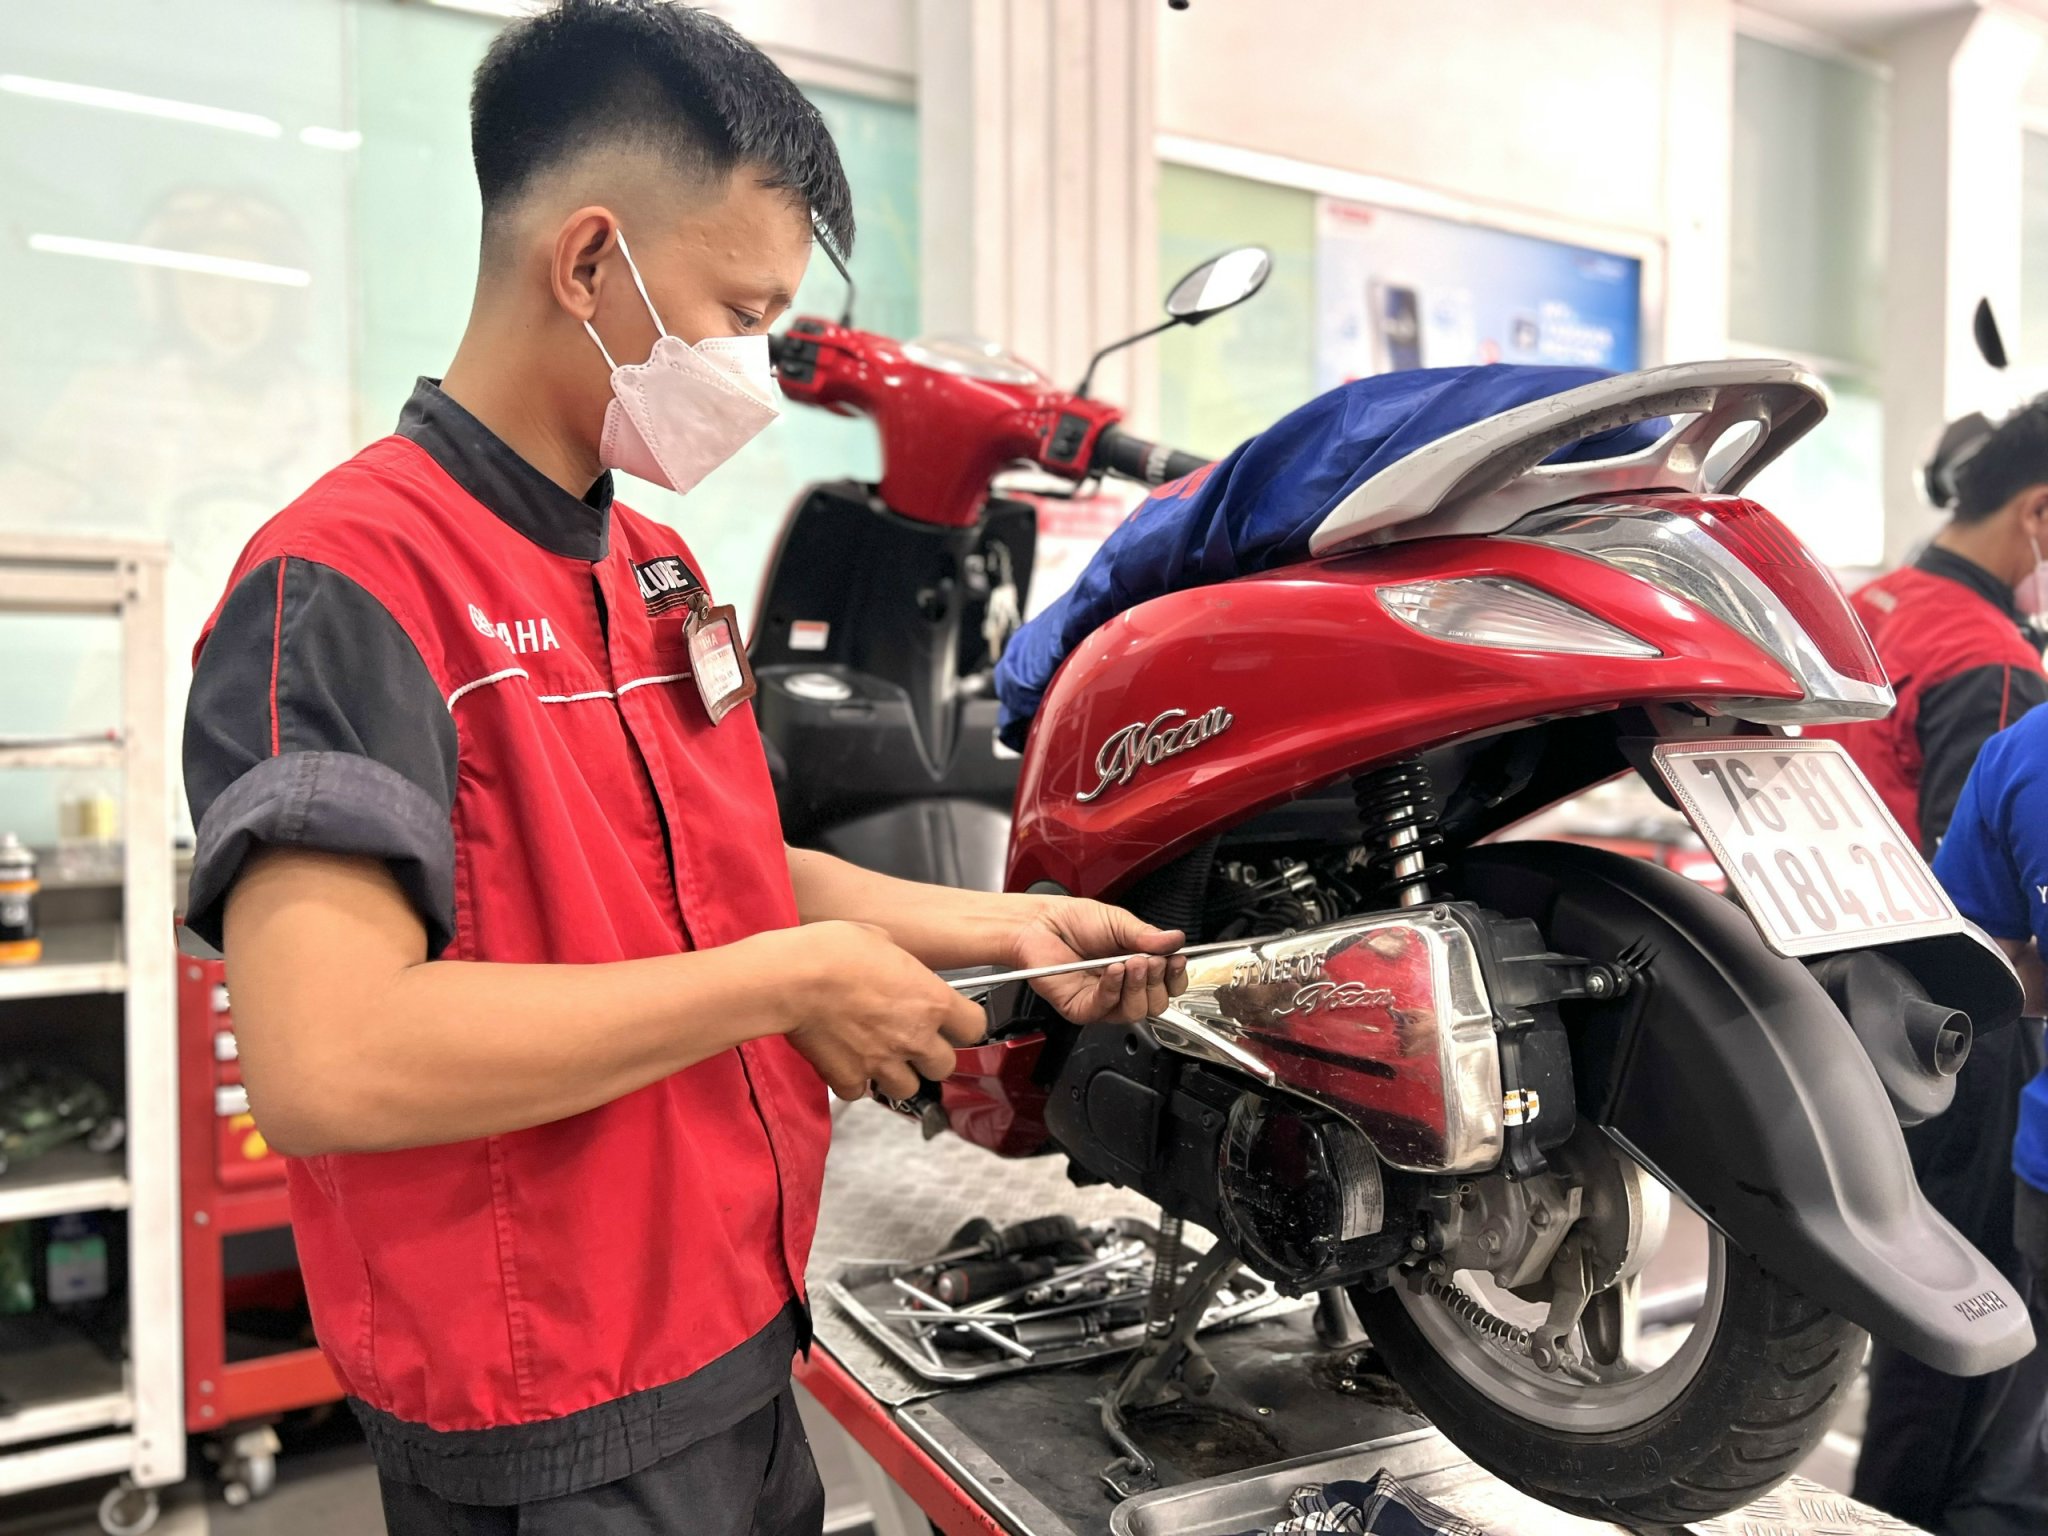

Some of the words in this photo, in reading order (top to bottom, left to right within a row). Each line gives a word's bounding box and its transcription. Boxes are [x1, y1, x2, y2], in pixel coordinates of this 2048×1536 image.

[1076, 706, 1234, 802] Nozza
[1693, 756, 1863, 836] 76-B1
[1742, 842, 1940, 935] 184.20
[1953, 1290, 2008, 1322] YAMAHA
